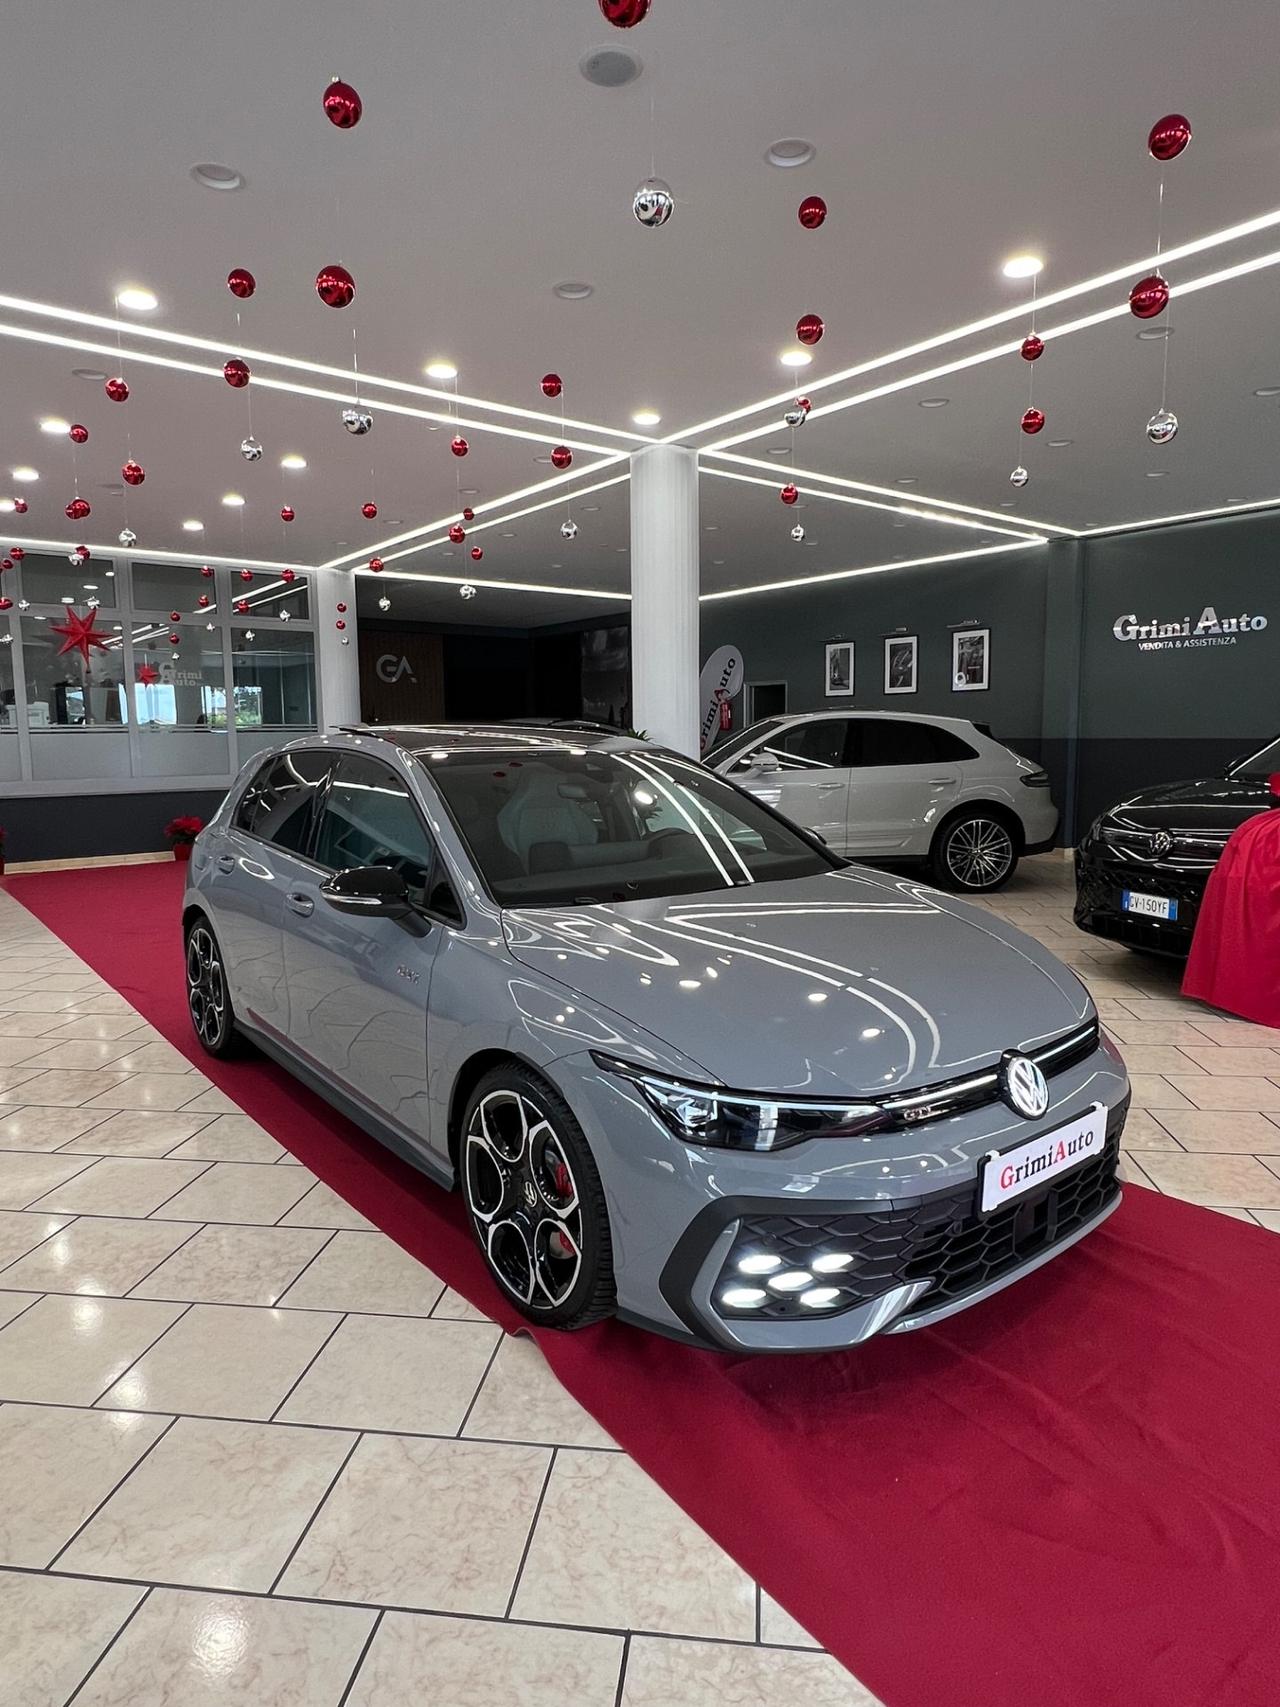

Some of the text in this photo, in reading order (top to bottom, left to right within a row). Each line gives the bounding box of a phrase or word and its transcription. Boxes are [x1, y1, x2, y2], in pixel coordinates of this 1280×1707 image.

[1138, 636, 1237, 651] VENDITA & ASSISTENZA
[1000, 1130, 1095, 1190] GrimiAuto
